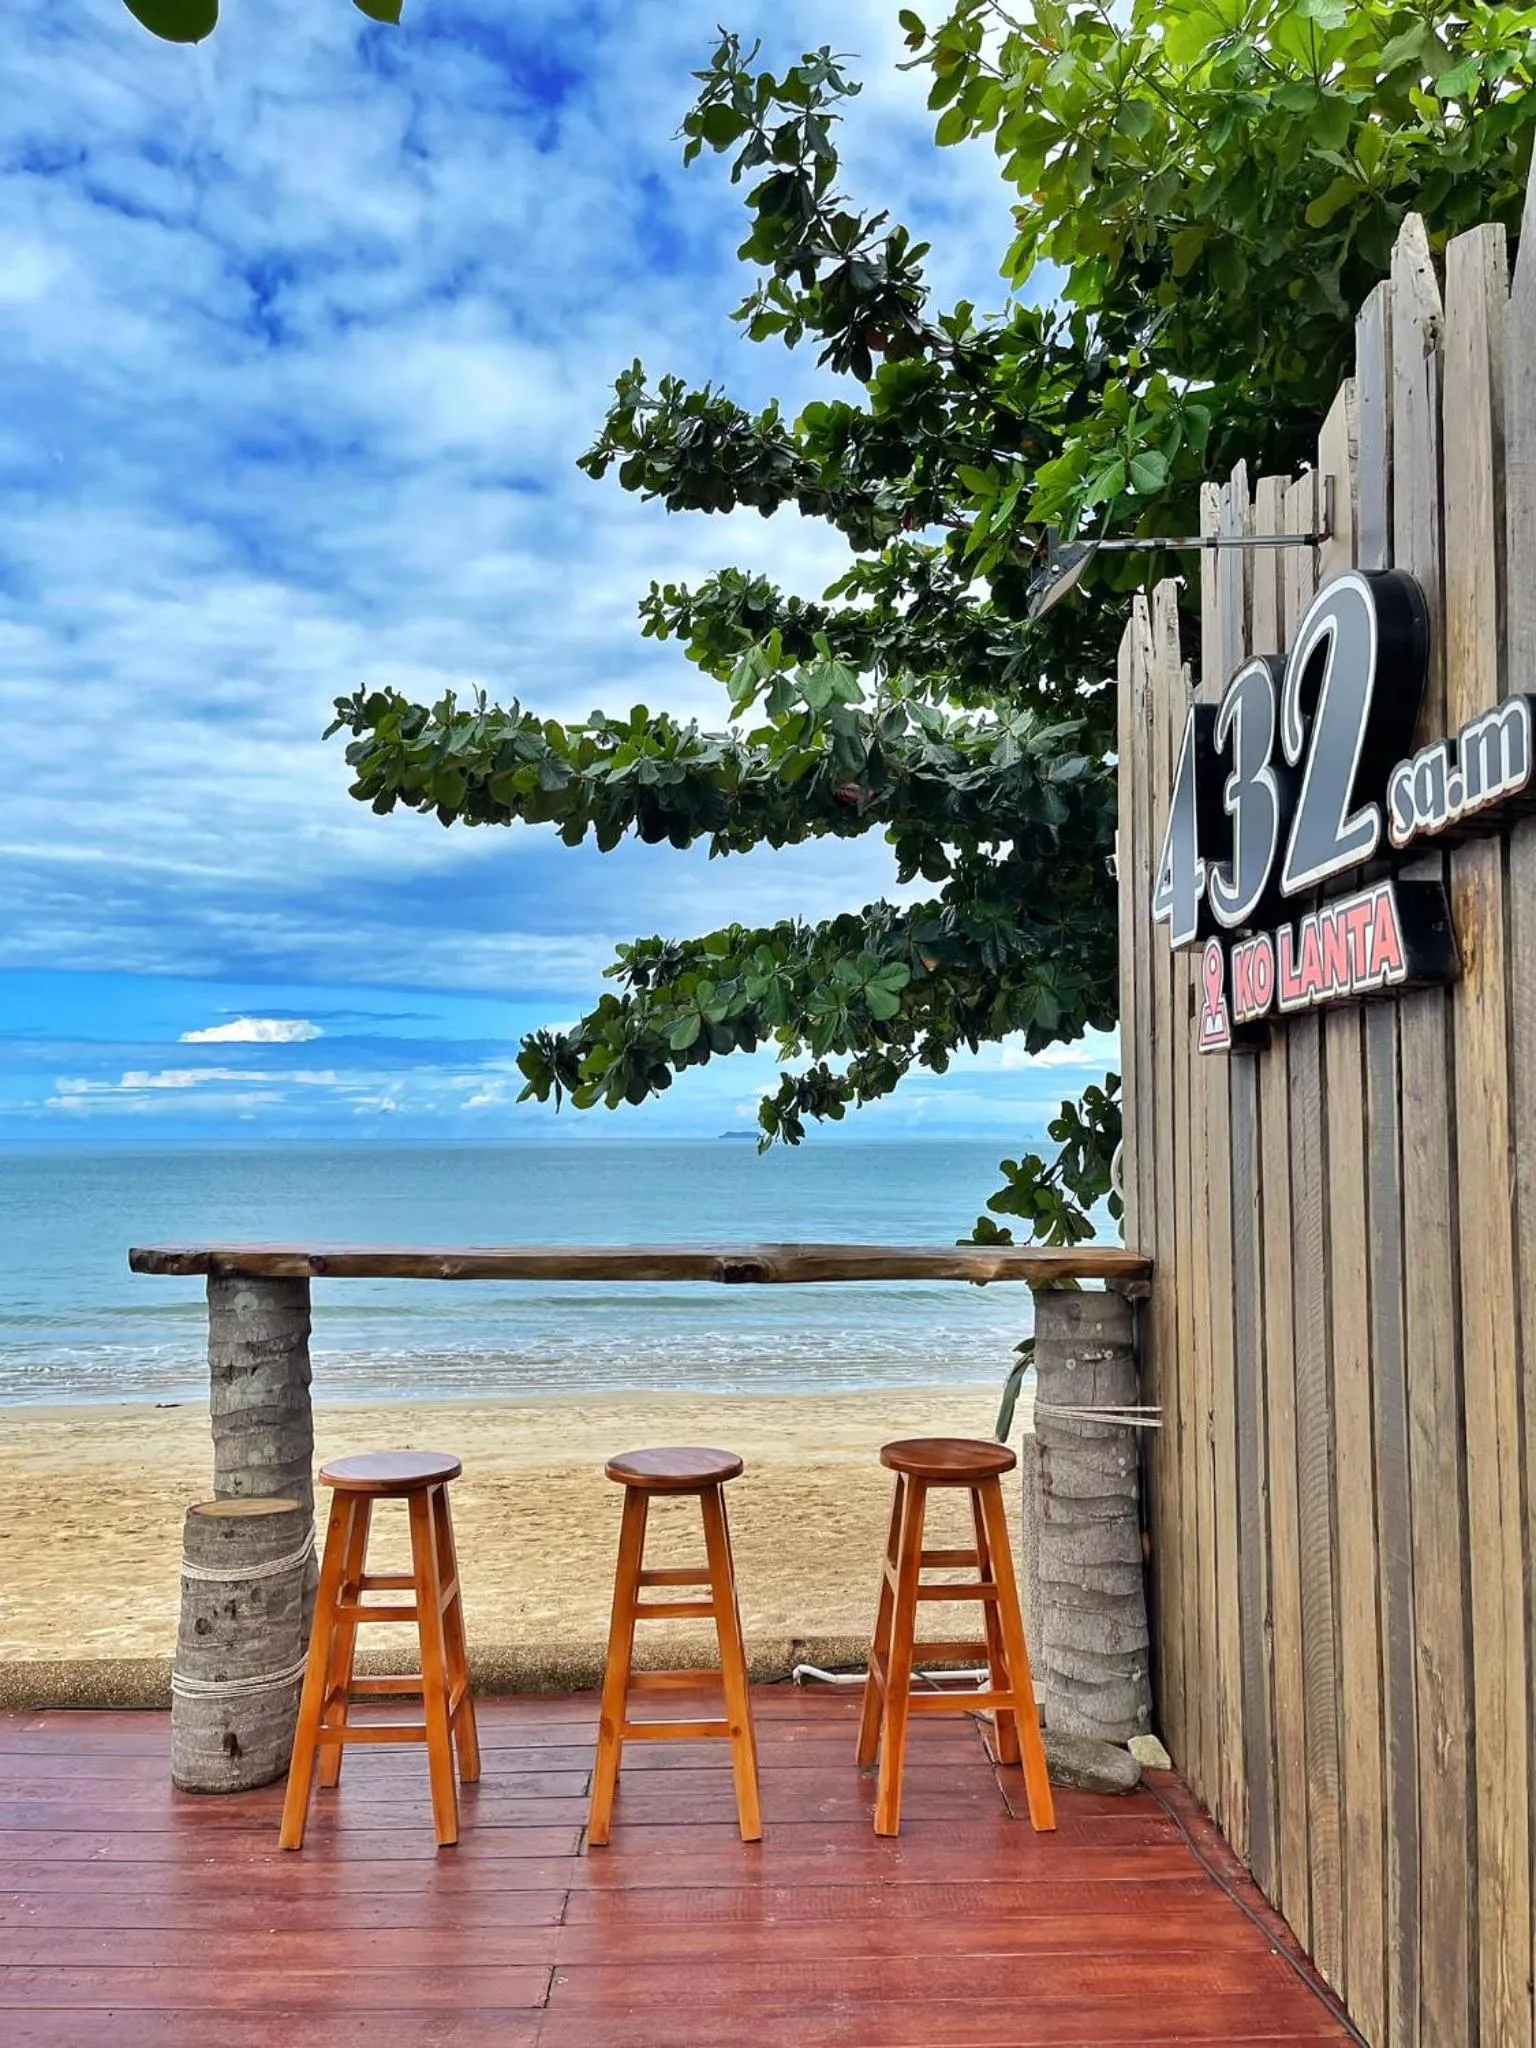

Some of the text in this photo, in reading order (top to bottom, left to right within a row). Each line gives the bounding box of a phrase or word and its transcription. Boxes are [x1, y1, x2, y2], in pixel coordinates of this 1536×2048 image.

[1152, 571, 1530, 950] 432 sq.m
[1232, 882, 1407, 1023] KO LANTA
